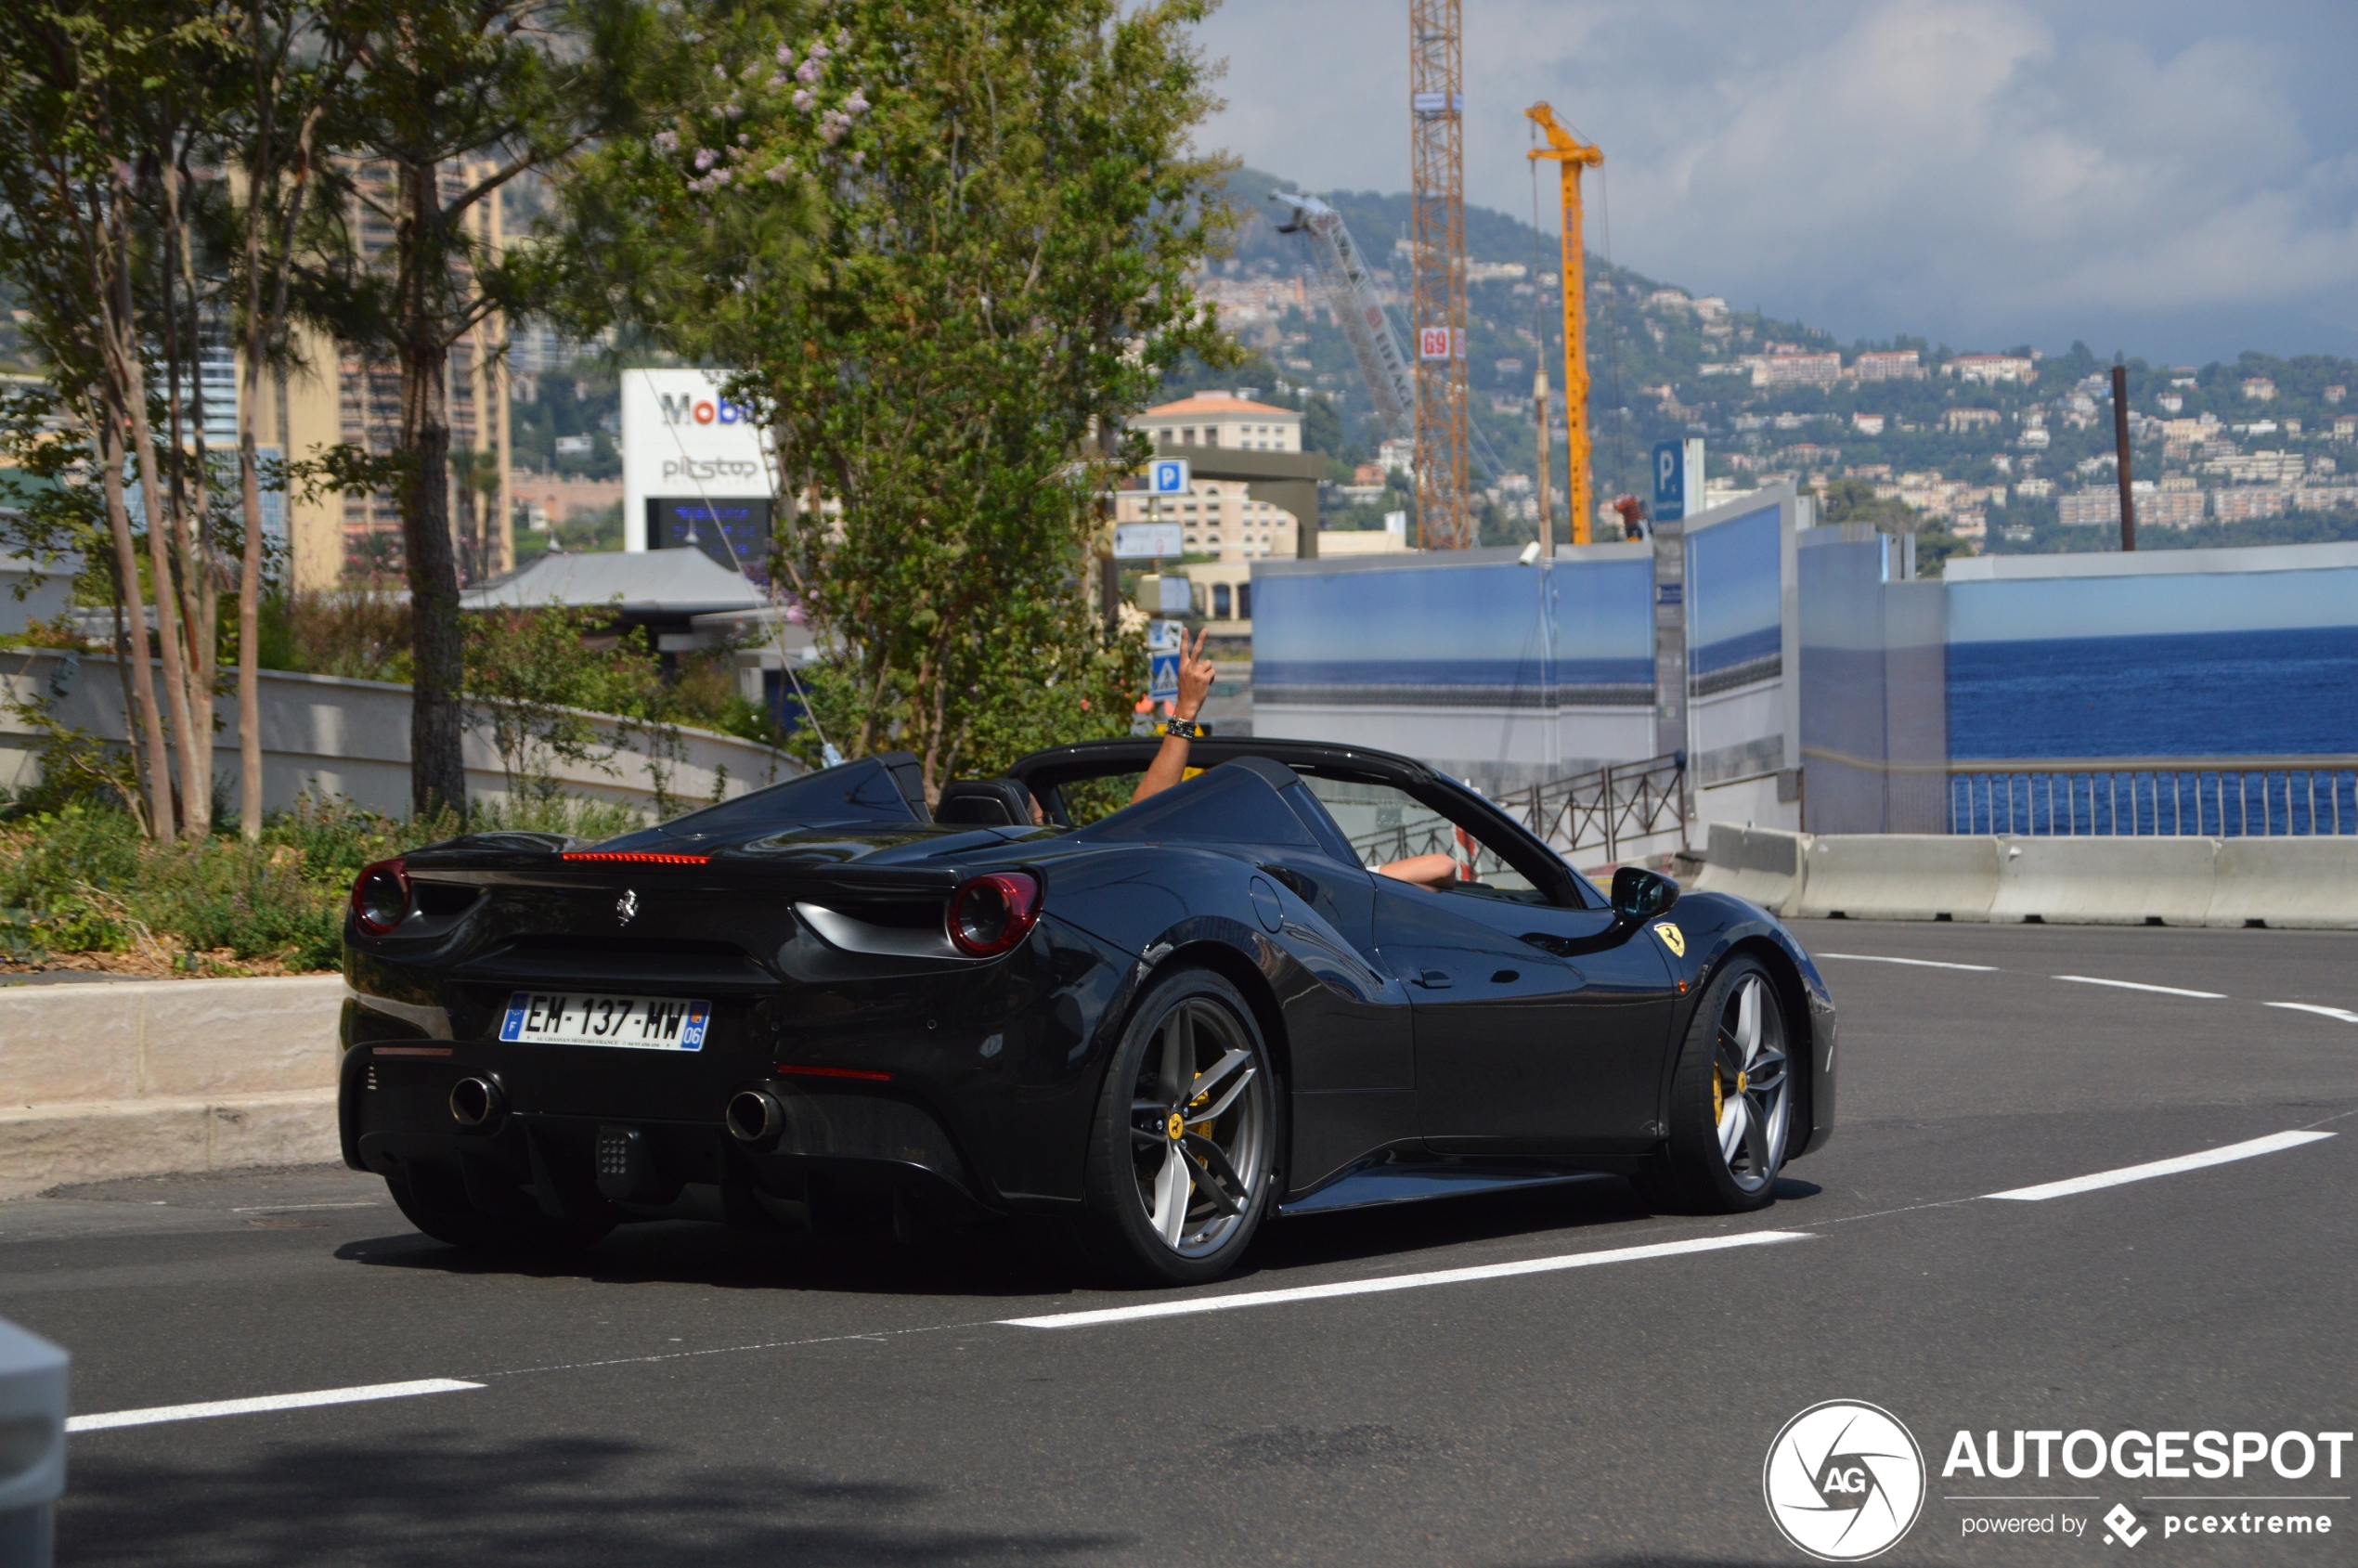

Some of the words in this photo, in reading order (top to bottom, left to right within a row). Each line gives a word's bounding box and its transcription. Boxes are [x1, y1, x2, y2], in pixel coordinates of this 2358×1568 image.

[662, 456, 758, 479] pitstop
[1161, 467, 1176, 488] P
[1660, 449, 1675, 490] P
[508, 1021, 517, 1031] F
[683, 1027, 701, 1044] 06
